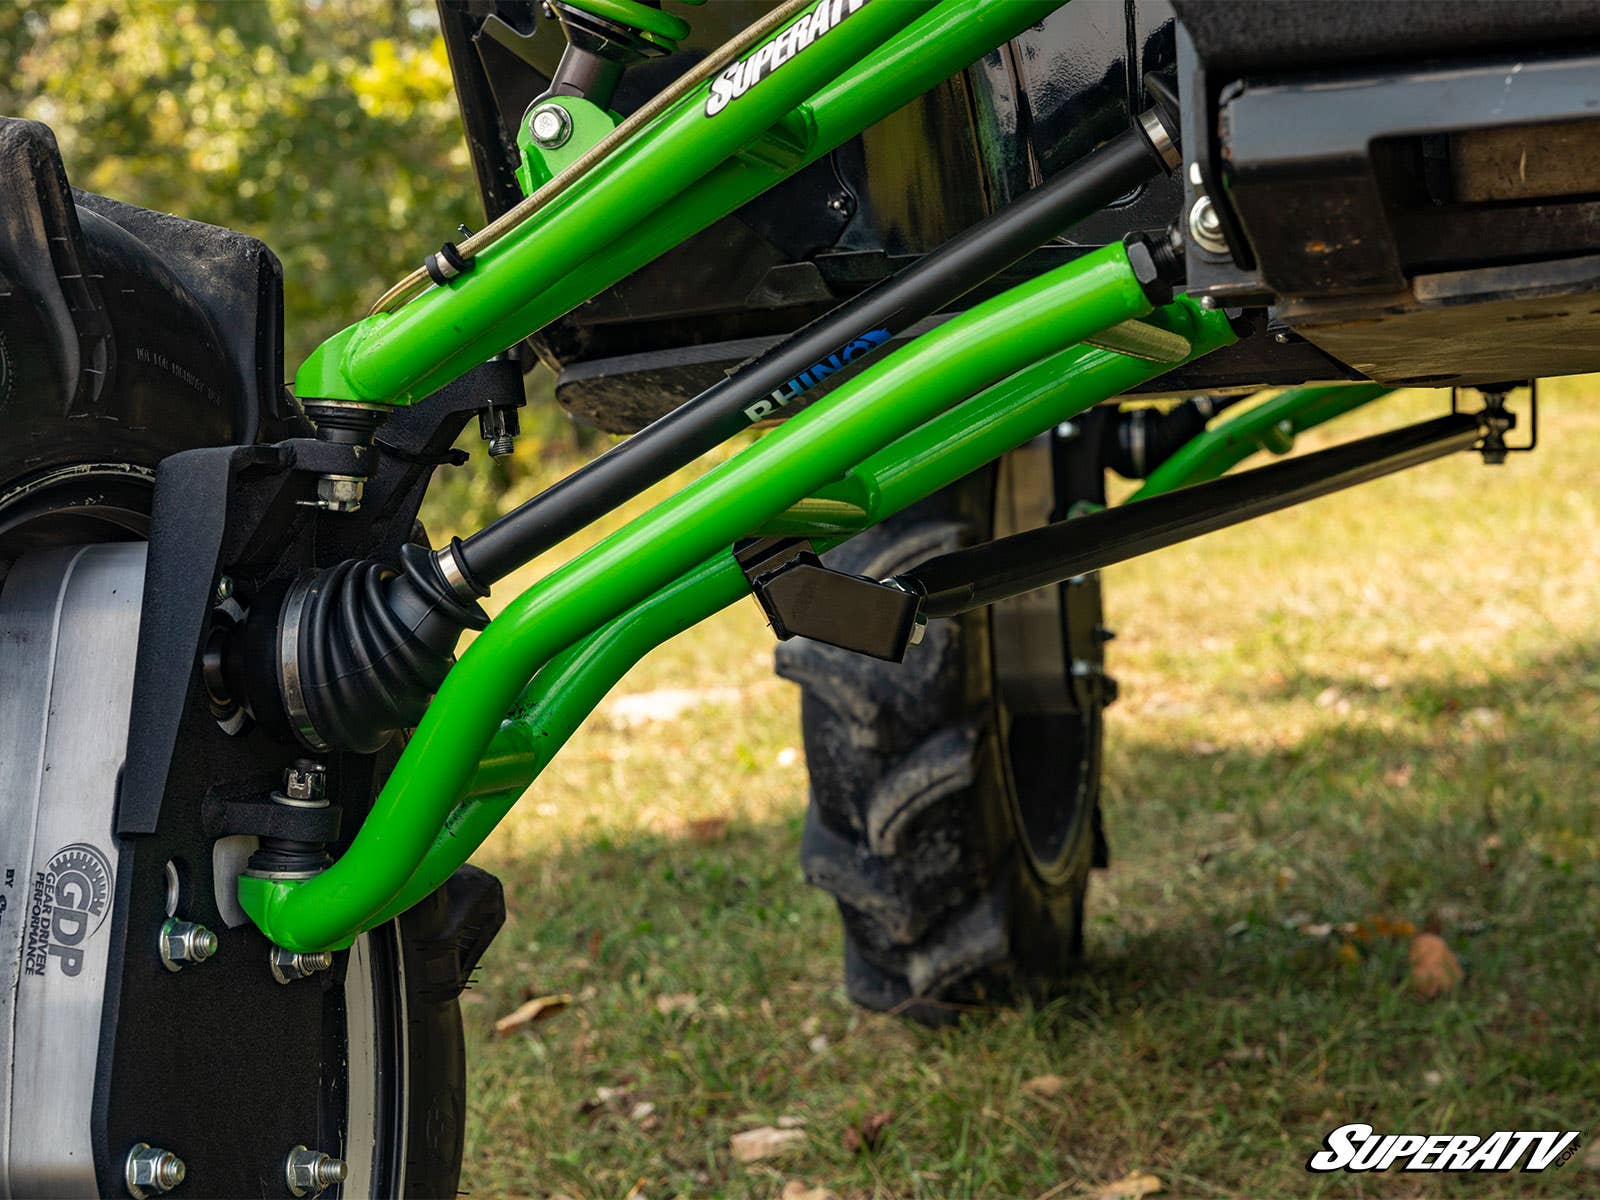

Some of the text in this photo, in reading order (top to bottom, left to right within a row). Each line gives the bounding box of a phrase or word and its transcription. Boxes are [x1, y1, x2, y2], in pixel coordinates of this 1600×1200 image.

[5, 868, 15, 888] BY
[25, 872, 45, 976] PERFORMANCE
[35, 873, 57, 976] GEAR DRIVEN
[48, 871, 91, 977] GDP
